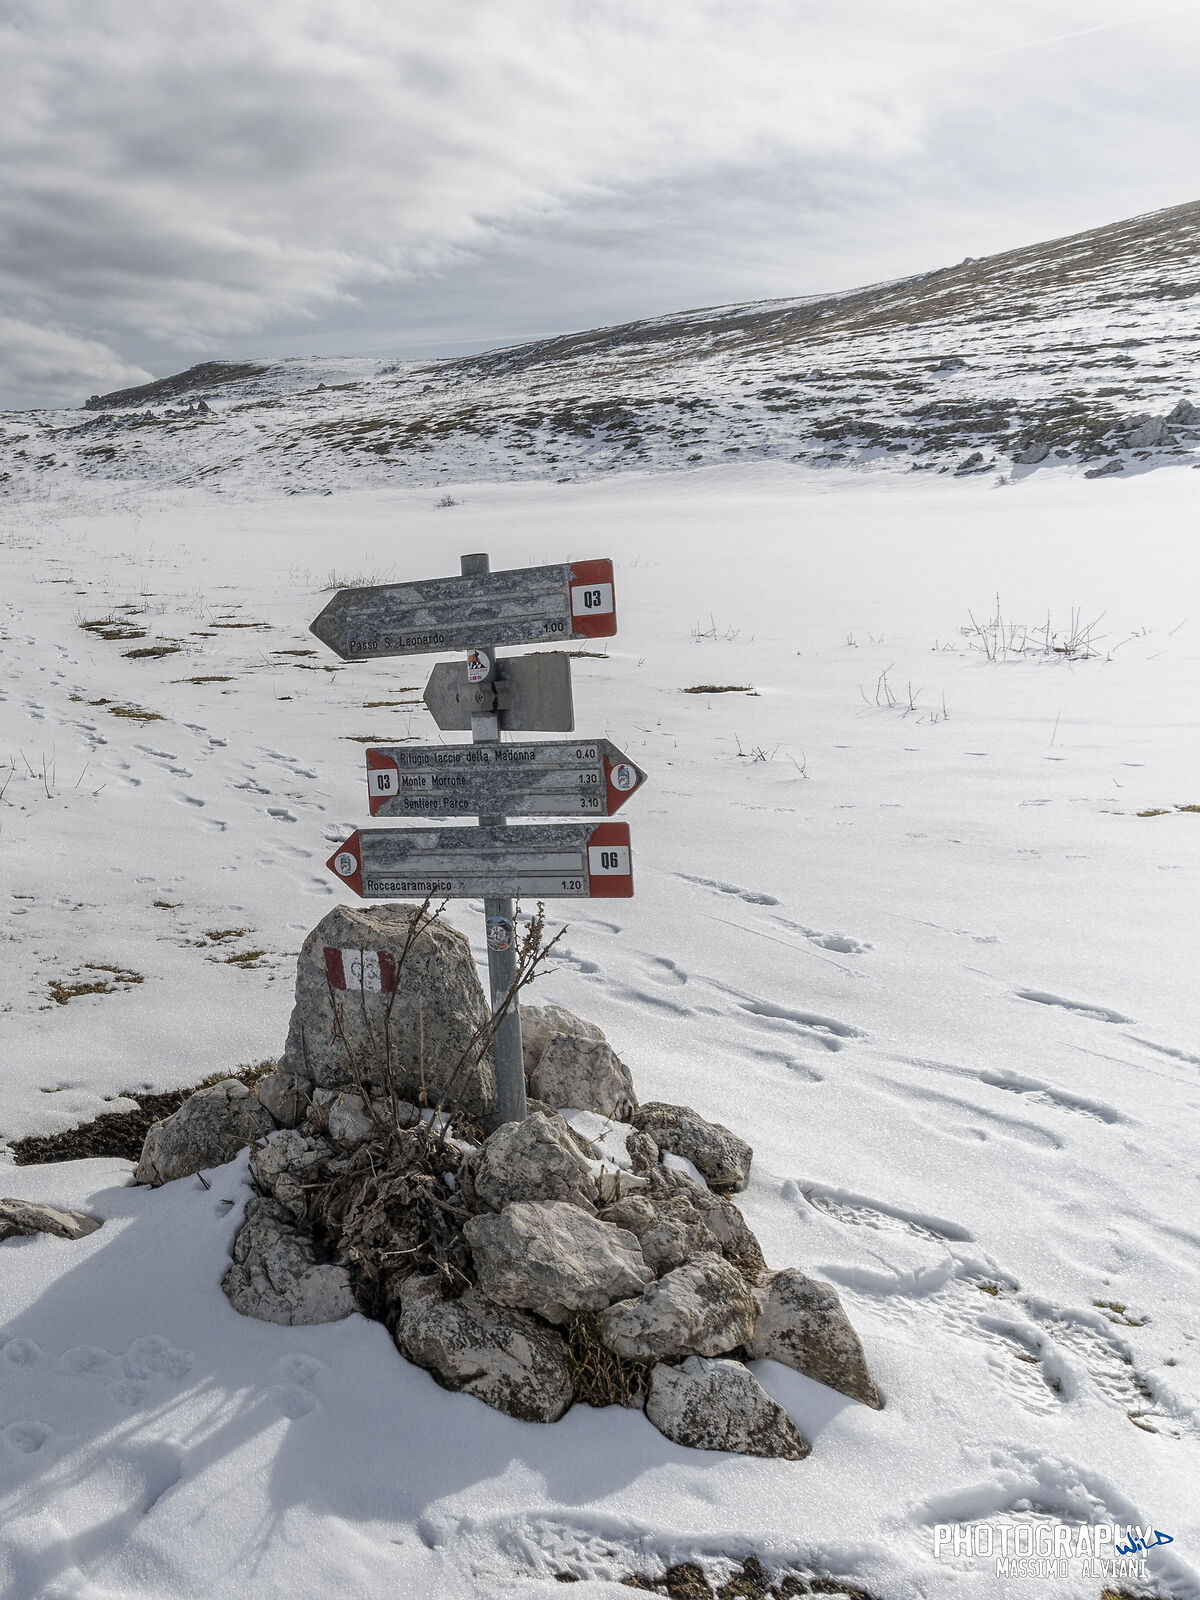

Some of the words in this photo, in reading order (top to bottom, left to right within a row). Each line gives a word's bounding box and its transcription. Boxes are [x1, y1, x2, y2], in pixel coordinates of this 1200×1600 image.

[583, 590, 602, 609] Q3
[350, 640, 378, 651] Passo
[399, 633, 445, 647] Leonardo
[544, 622, 564, 633] 1.00
[400, 753, 429, 766] Rifugio
[466, 750, 489, 762] della
[494, 750, 536, 761] Madonna
[576, 749, 596, 759] 0.40
[377, 774, 391, 791] Q3
[401, 776, 427, 787] Monte
[431, 775, 467, 786] Morrone
[578, 774, 597, 784] 1.30
[403, 798, 439, 809] Sentiero
[443, 797, 469, 809] Parco
[580, 798, 599, 808] 3.10
[601, 852, 619, 869] Q6
[561, 880, 582, 890] 1.20
